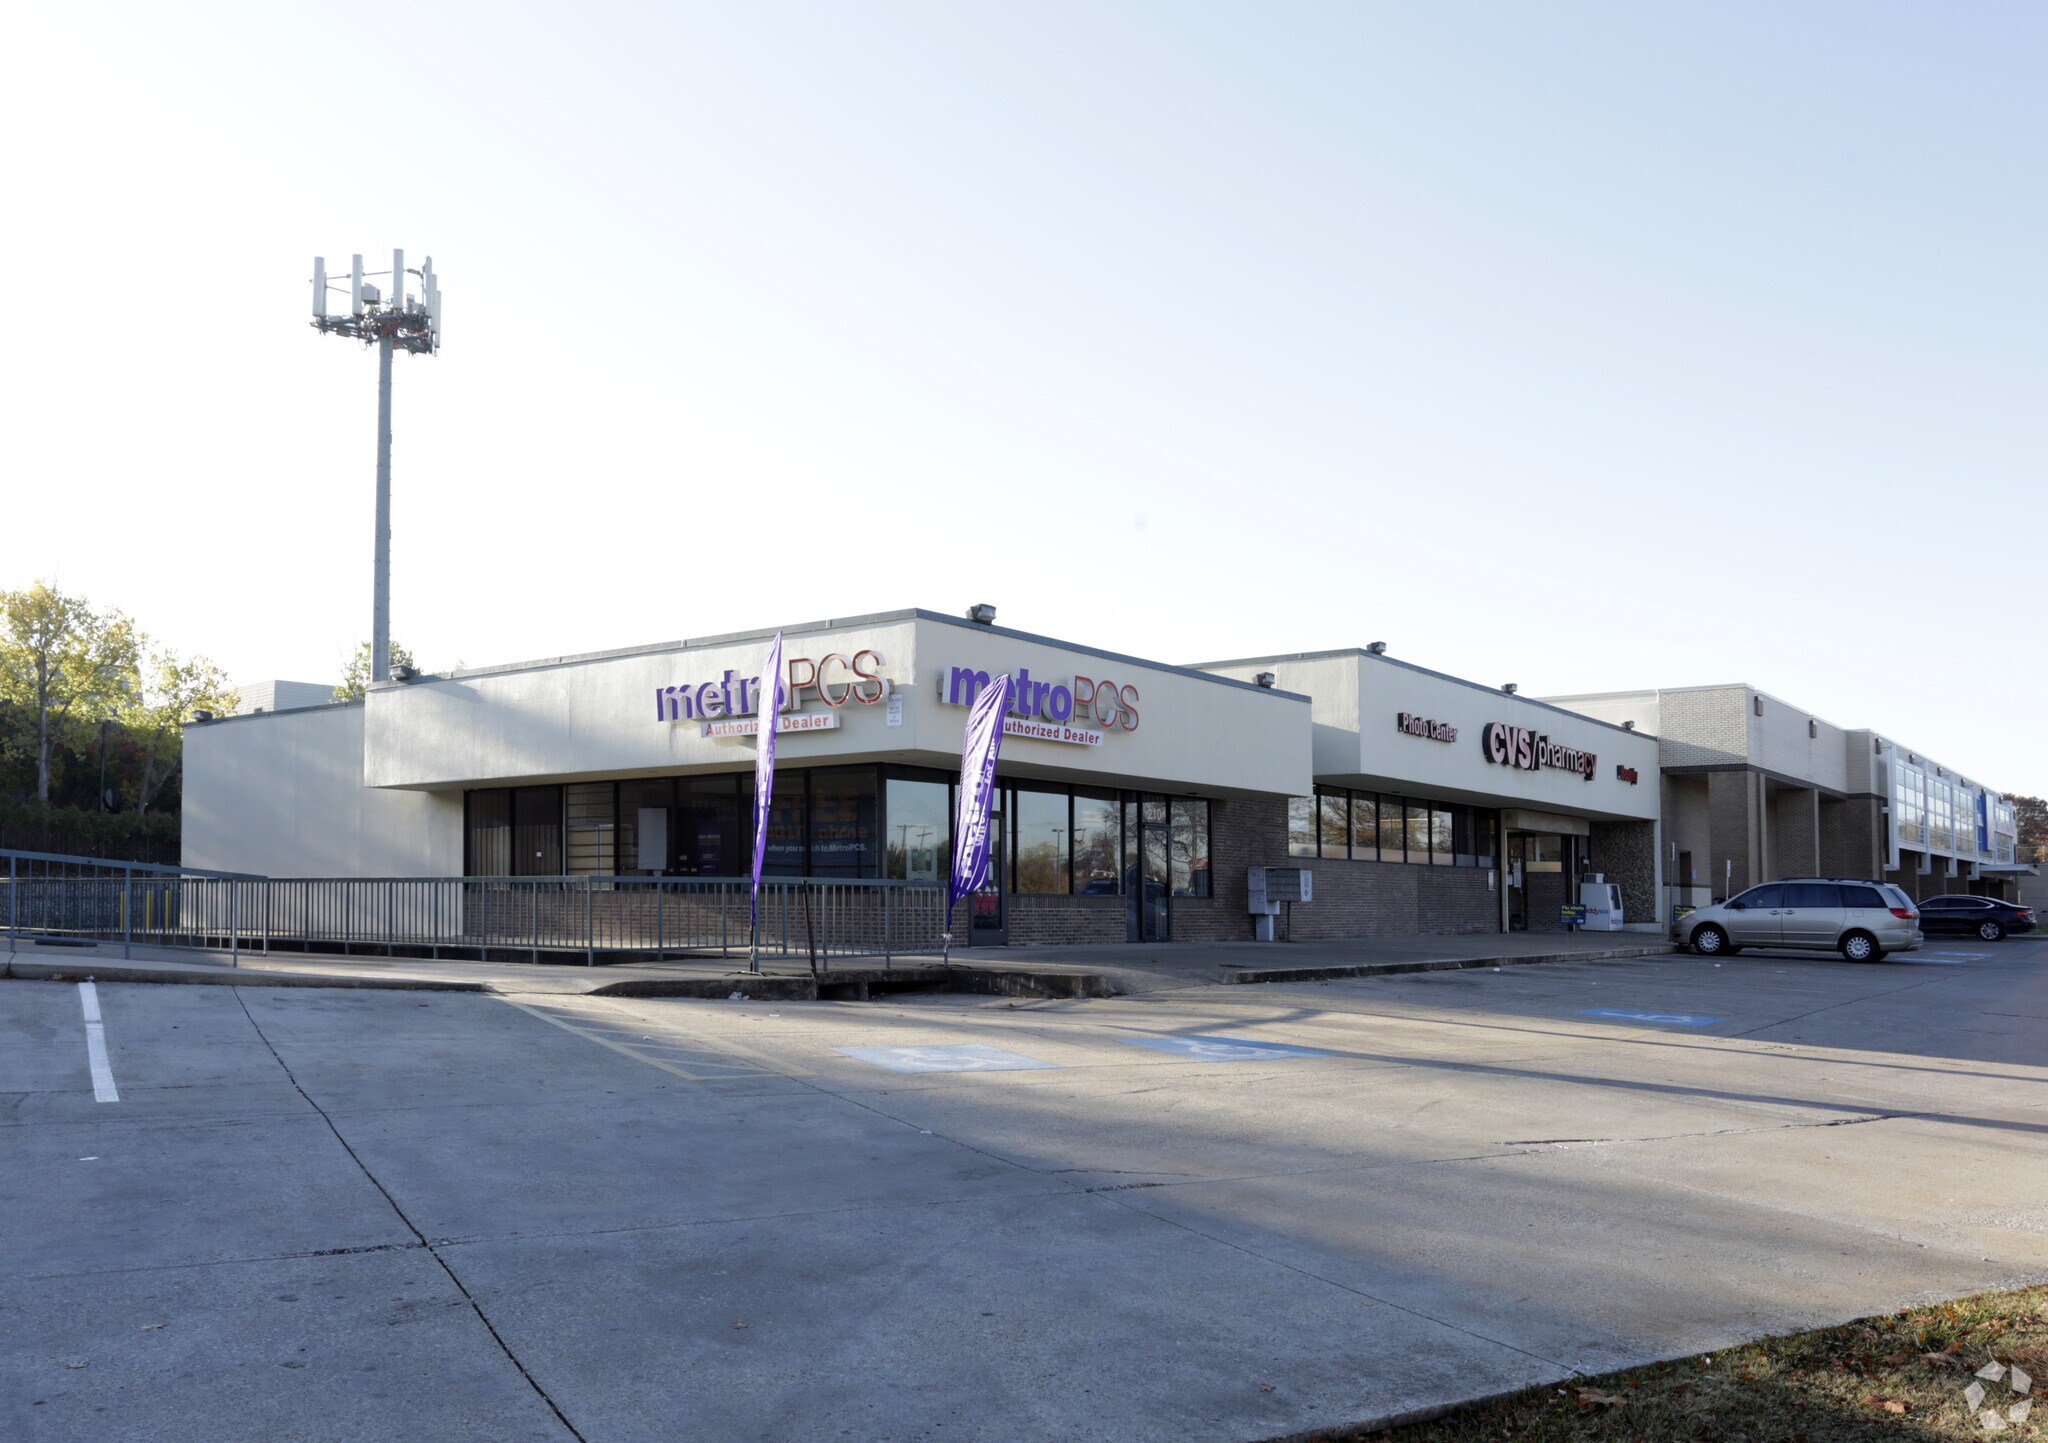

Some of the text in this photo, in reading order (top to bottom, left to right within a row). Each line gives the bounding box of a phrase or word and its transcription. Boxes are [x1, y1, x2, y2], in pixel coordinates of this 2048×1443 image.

[706, 715, 829, 737] Authoriz Dealer
[1004, 722, 1100, 744] uthorized Dealer
[1401, 712, 1457, 742] Photo Center
[1486, 722, 1597, 780] CVS/pharmacy
[1147, 807, 1162, 821] 210
[768, 844, 785, 852] when
[785, 845, 797, 853] you
